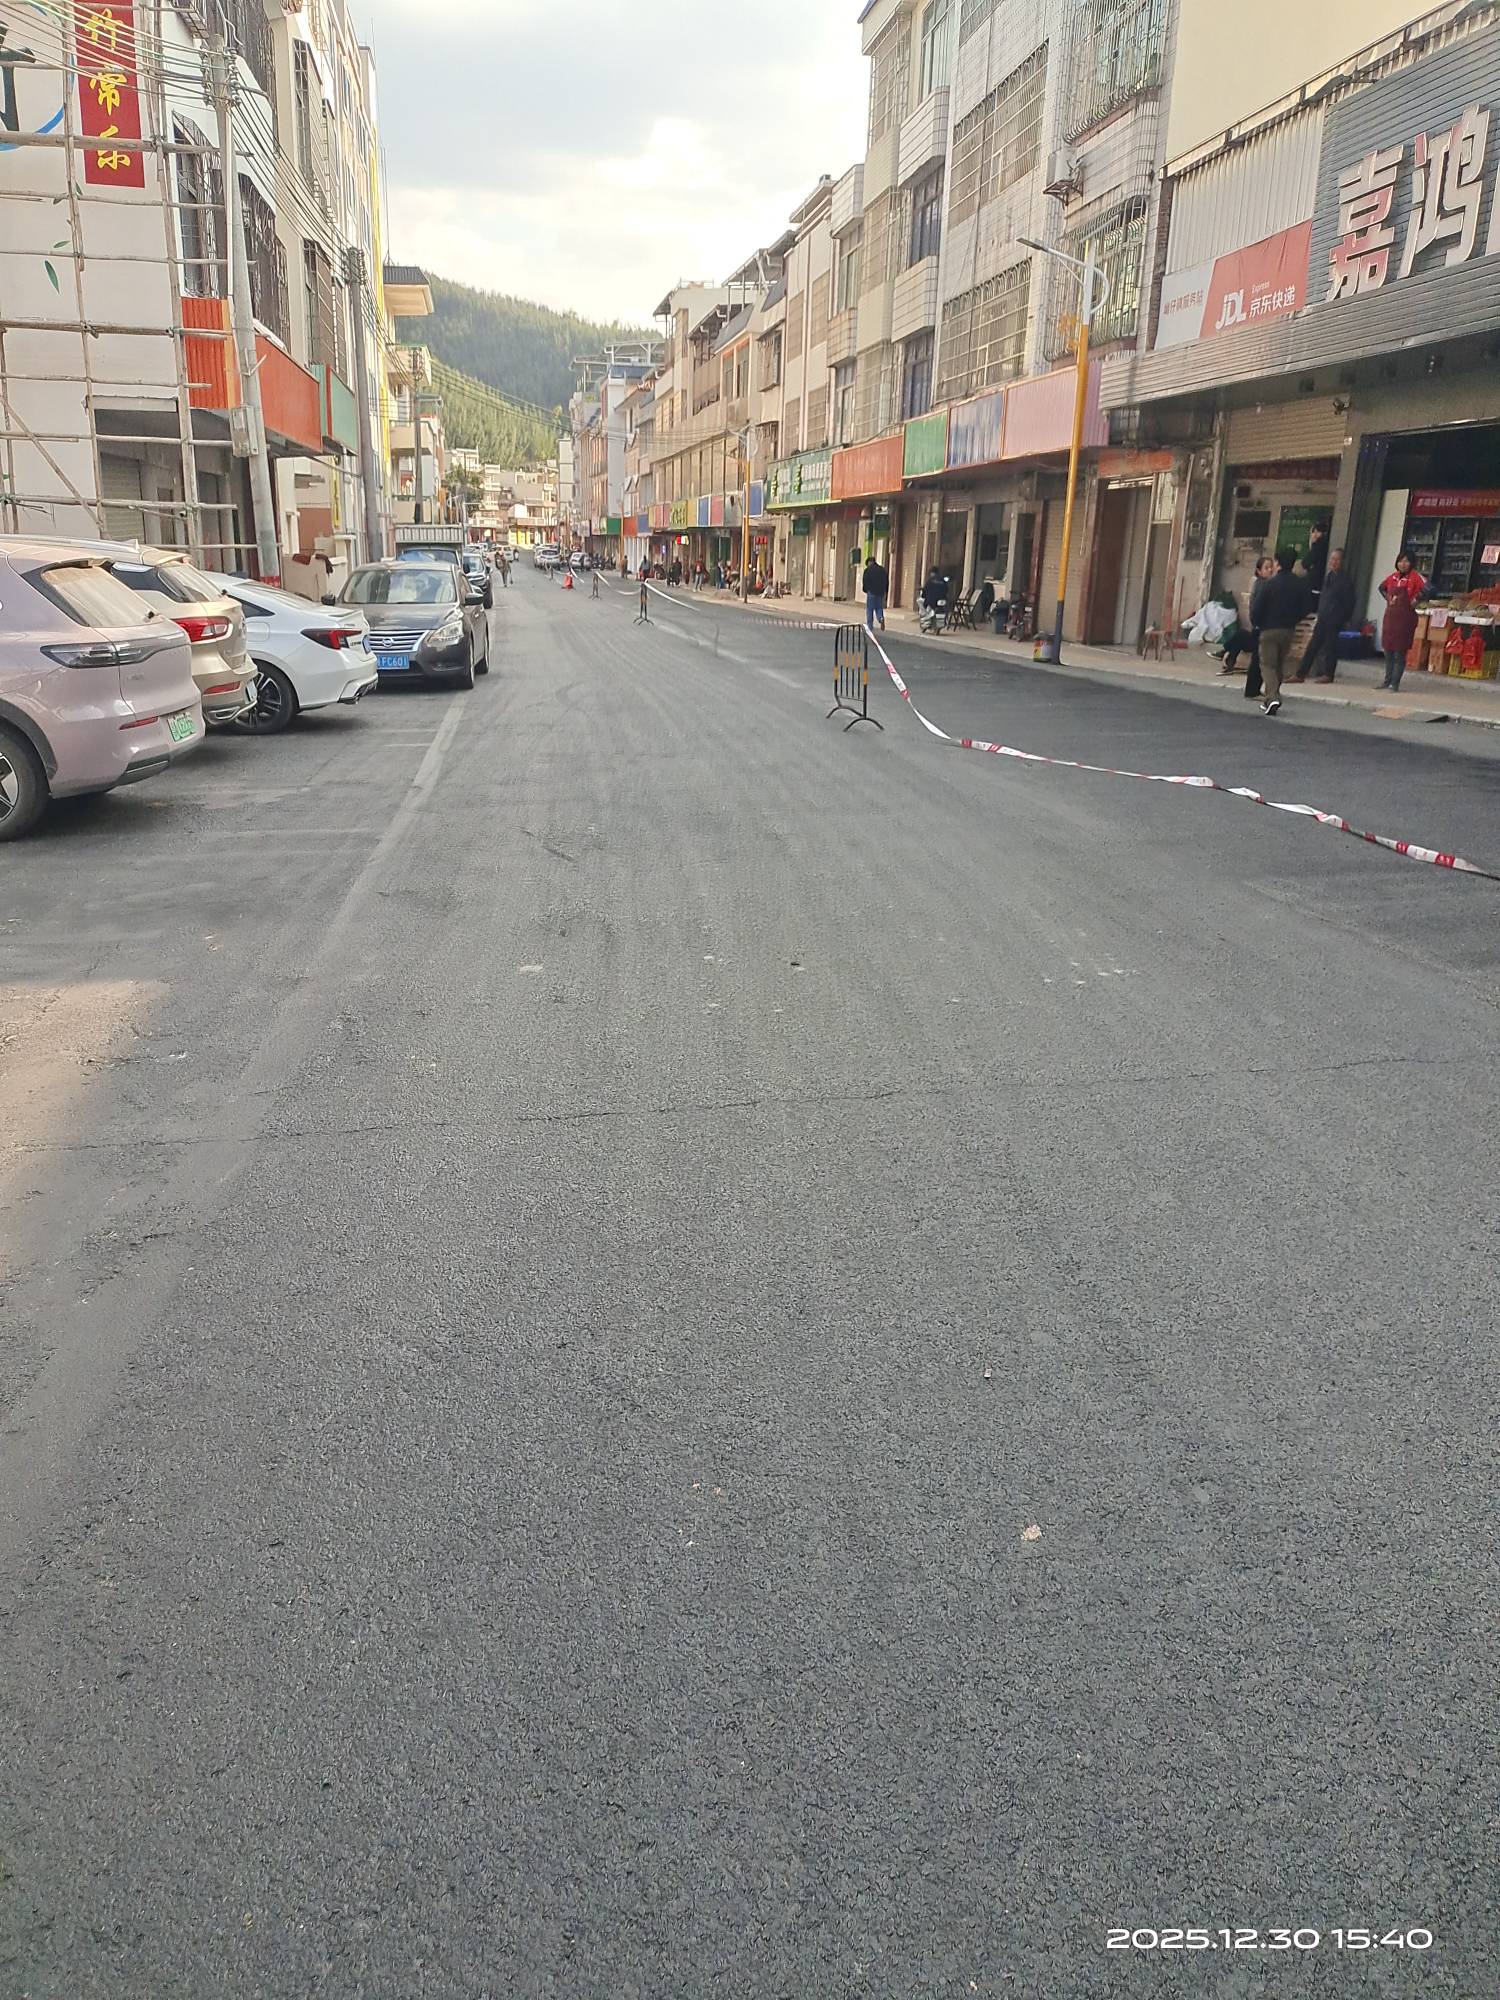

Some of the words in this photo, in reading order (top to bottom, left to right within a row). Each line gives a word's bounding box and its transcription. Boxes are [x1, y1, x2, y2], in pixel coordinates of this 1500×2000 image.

[1324, 103, 1500, 302] 嘉鸿
[1215, 289, 1247, 330] JDL
[1248, 284, 1296, 318] 京东快递
